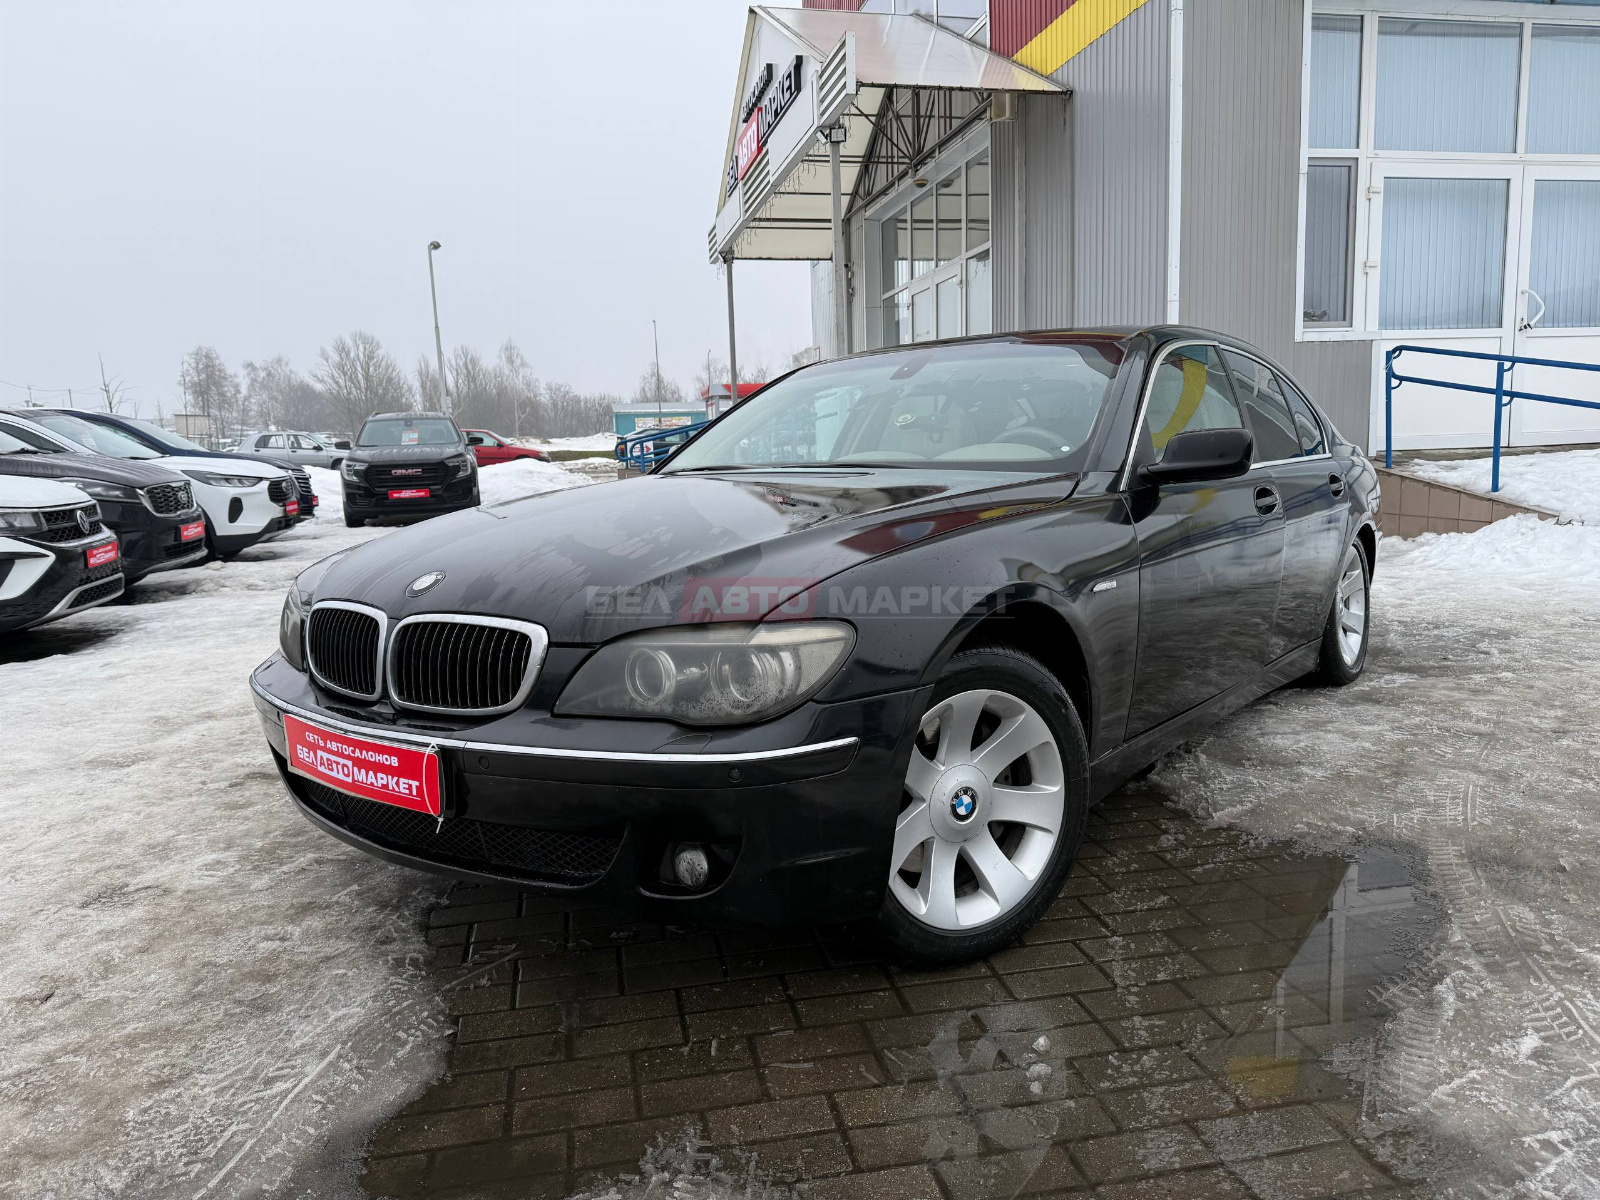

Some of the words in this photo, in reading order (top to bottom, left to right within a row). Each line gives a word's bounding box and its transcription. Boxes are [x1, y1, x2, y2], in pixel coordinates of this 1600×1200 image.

[739, 120, 757, 171] АВТО
[759, 55, 803, 140] МАРКЕТ
[391, 468, 422, 476] GMC
[296, 743, 318, 766] БЕЛ
[319, 754, 351, 778] АВТО
[353, 766, 420, 796] МАРКЕТ
[305, 731, 325, 747] СЕТЬ
[326, 739, 399, 766] АВТОСАЛОНОВ
